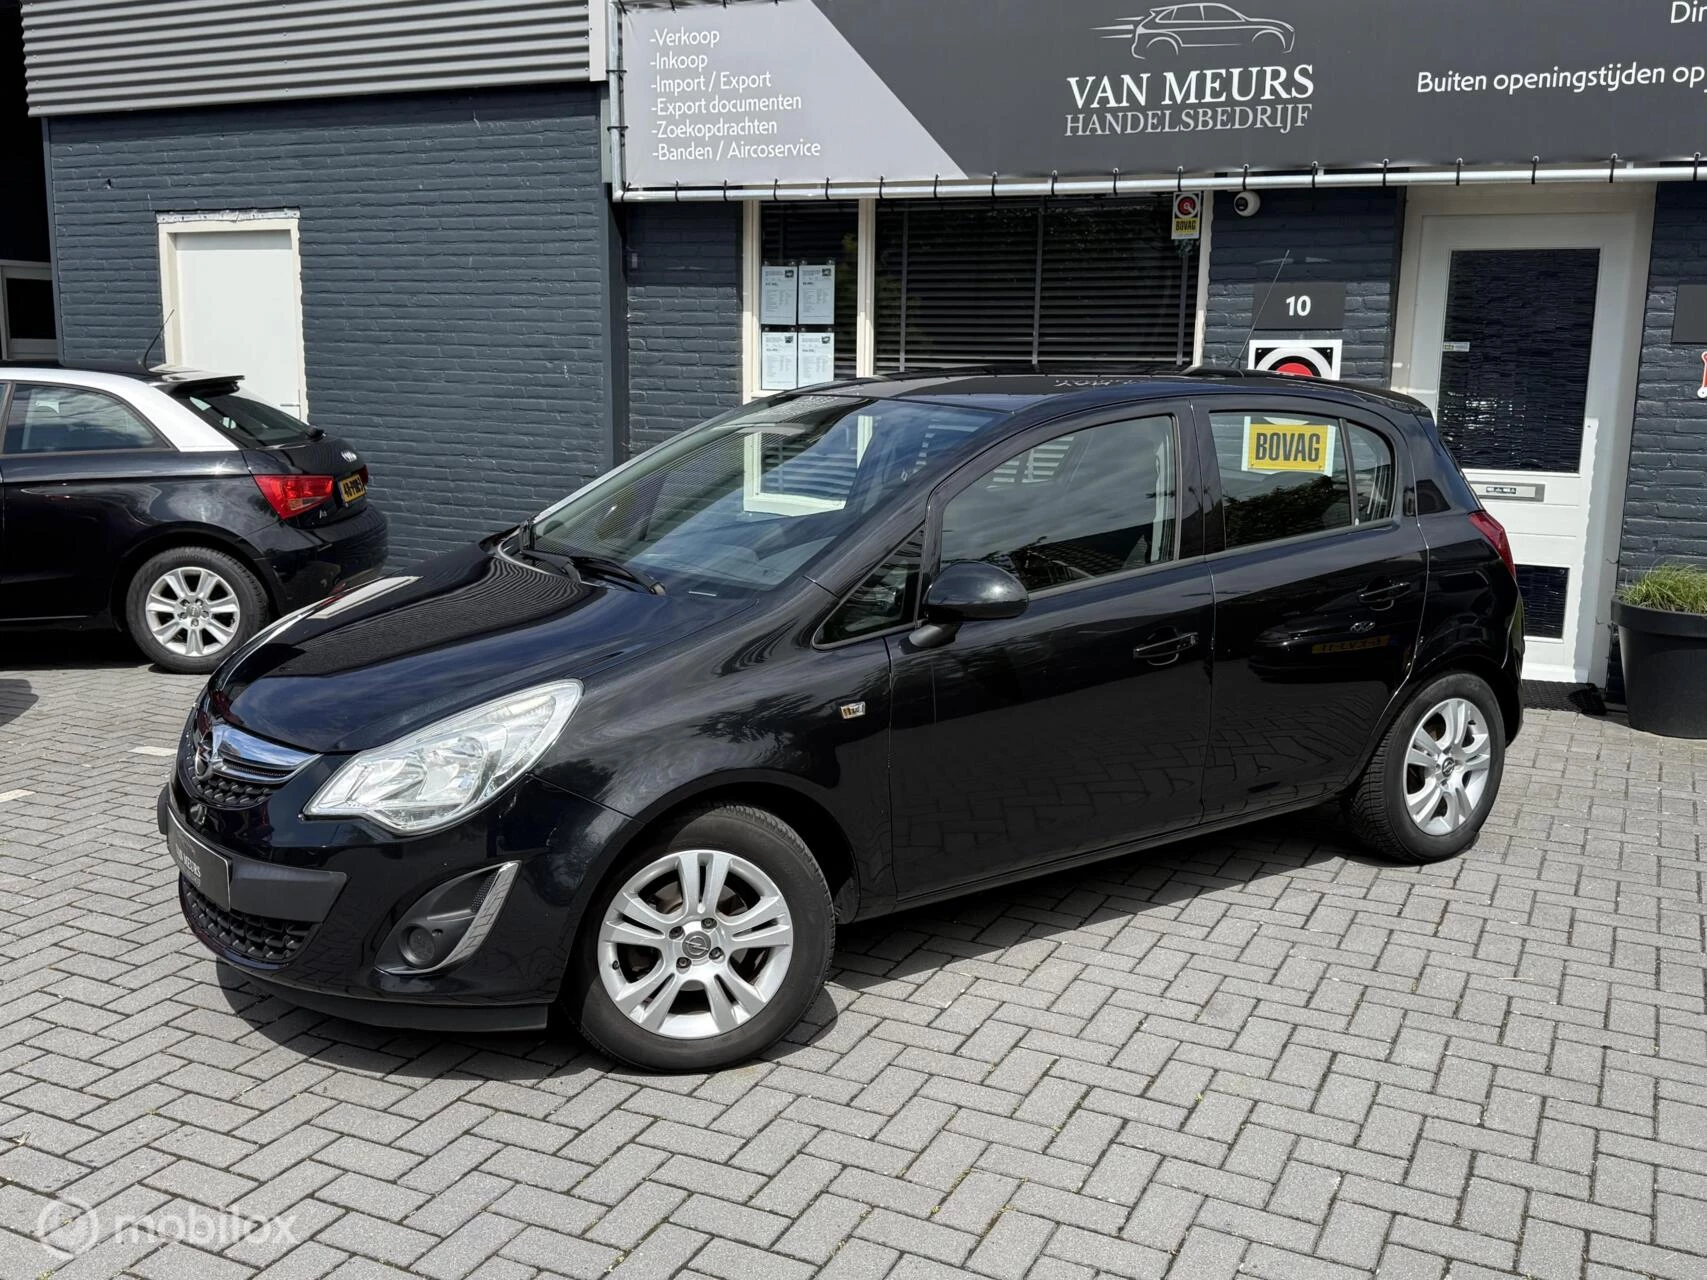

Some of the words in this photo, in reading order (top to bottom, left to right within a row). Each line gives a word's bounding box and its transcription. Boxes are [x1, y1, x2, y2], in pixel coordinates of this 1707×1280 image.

[649, 26, 720, 49] -Verkoop
[649, 50, 708, 72] -Inkoop
[650, 74, 706, 97] -Import
[708, 71, 716, 93] /
[720, 71, 772, 93] Export
[1066, 73, 1151, 109] VAN
[1160, 64, 1315, 105] MEURS
[1417, 70, 1487, 93] Buiten
[1493, 61, 1666, 95] openingstijden
[1672, 66, 1706, 89] op
[650, 97, 708, 119] -Export
[709, 94, 802, 114] documenten
[651, 116, 778, 141] -Zoekopdrachten
[1065, 103, 1312, 136] HANDELSBEDRIJF
[652, 141, 713, 161] -Banden
[715, 140, 725, 161] /
[727, 137, 821, 159] Aircoservice
[1175, 220, 1197, 231] BOVAG
[1285, 295, 1312, 317] 10
[1255, 432, 1321, 462] BOVAG
